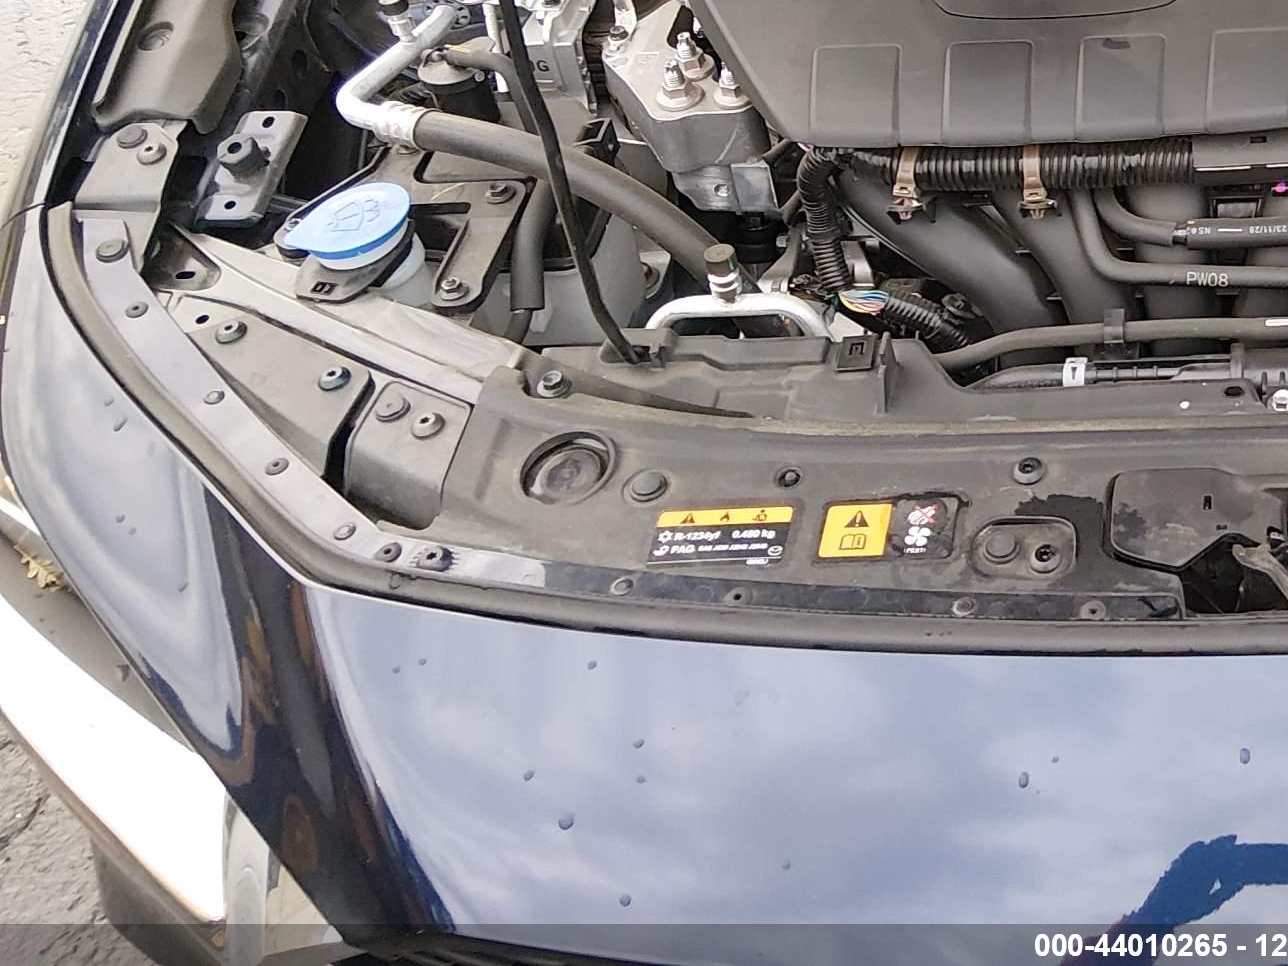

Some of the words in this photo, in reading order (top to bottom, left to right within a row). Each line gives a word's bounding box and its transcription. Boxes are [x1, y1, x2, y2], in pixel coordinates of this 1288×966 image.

[1186, 271, 1229, 287] PW08
[760, 529, 777, 539] kg
[670, 545, 696, 555] PAG
